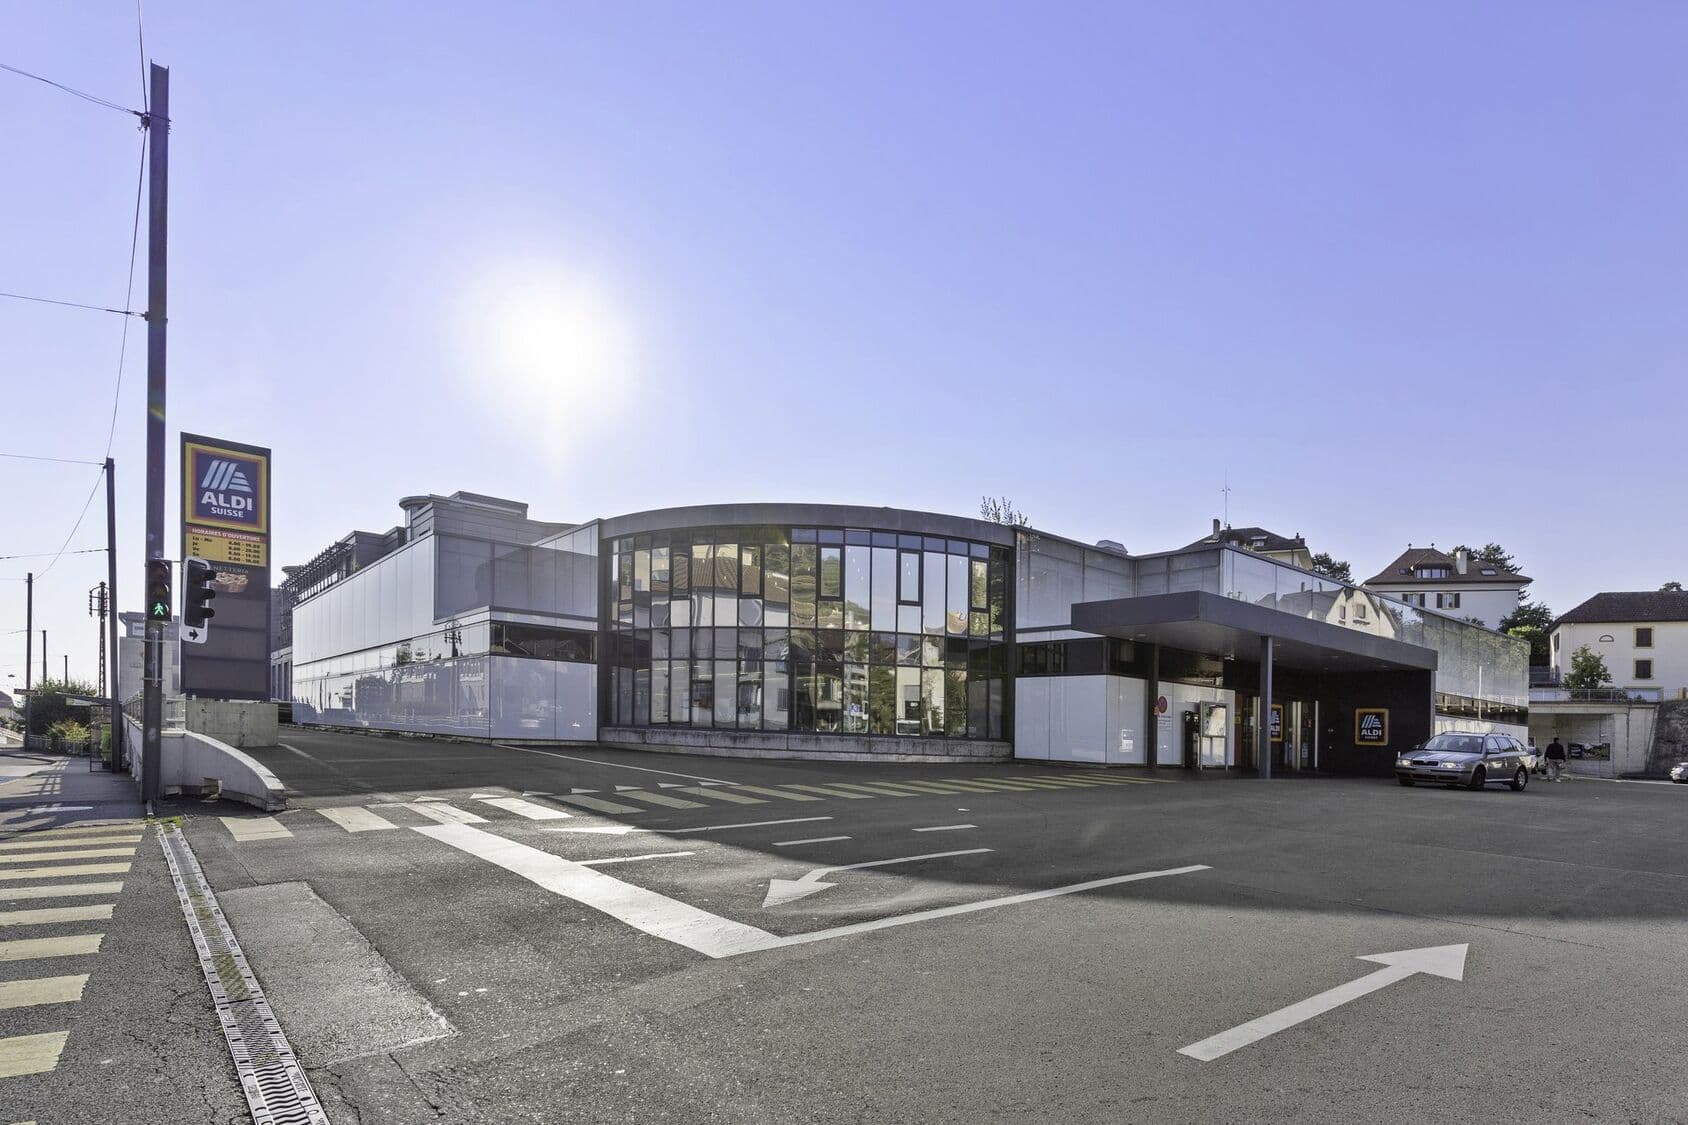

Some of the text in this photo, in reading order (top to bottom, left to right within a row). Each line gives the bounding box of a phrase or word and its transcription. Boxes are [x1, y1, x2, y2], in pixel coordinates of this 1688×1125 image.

[201, 491, 253, 511] ALDI
[210, 506, 244, 518] SUISSE
[191, 527, 261, 542] HORAIRES D'OUVERTURE
